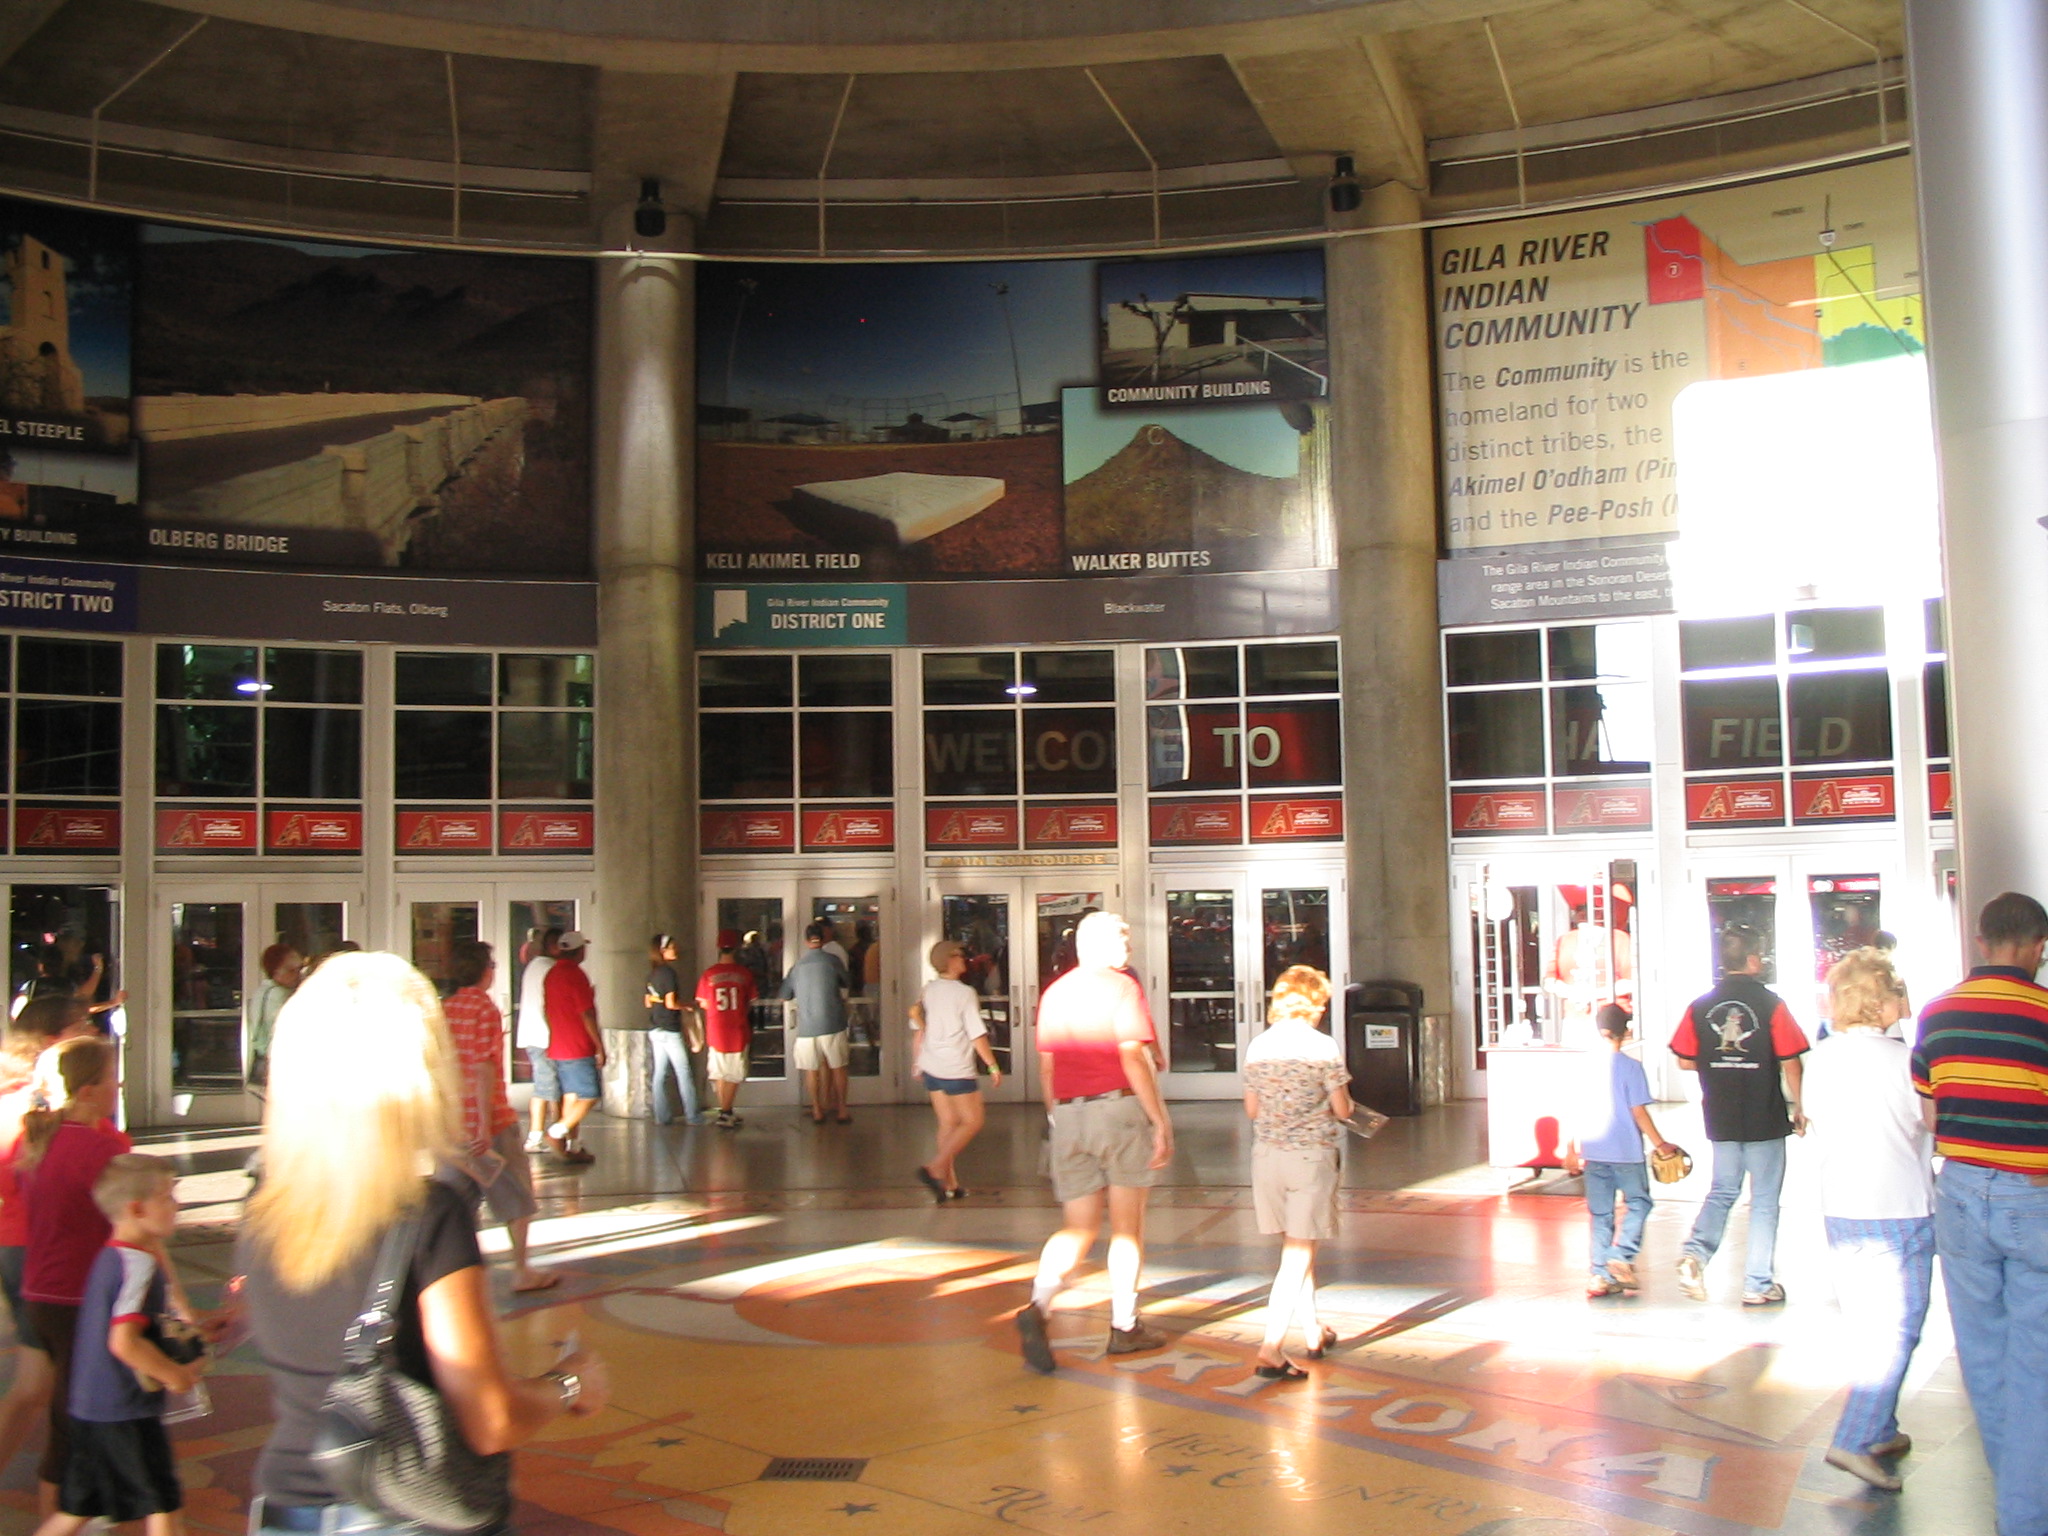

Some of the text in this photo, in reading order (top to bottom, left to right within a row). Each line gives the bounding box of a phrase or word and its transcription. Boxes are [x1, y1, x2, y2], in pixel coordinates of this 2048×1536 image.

[1441, 231, 1610, 275] GILA RIVER
[1442, 276, 1550, 313] INDIAN
[1444, 302, 1641, 350] COMMUNITY
[1442, 350, 1689, 392] The Community is the
[1108, 379, 1271, 403] COMMUNITY BUILDING
[1446, 391, 1648, 427] homeland for two
[16, 420, 85, 441] STEEPLE
[1447, 425, 1663, 463] distinct tribes, the
[1450, 472, 1526, 497] Akimel
[1533, 465, 1627, 491] O'odham
[1450, 511, 1491, 534] and
[1500, 508, 1538, 529] the
[1548, 496, 1653, 526] Pee-Posh
[149, 528, 289, 554] OLBERG BRIDGE
[706, 552, 862, 569] KELI AKIMEL FIELD
[1072, 550, 1212, 572] WALKER BUTTES
[1482, 553, 1665, 577] The Gila River Indian Community
[27, 574, 60, 586] Indian
[61, 576, 118, 591] Community
[1491, 581, 1523, 595] range
[1525, 580, 1550, 591] area
[1566, 576, 1586, 588] the
[1587, 573, 1634, 587] Sonoran
[70, 593, 115, 614] TWO
[323, 598, 371, 615] Sacaton
[409, 602, 450, 619] Olberg
[841, 597, 890, 609] Community
[1104, 600, 1166, 616] Blackwater
[1490, 597, 1536, 610] Sacaton
[1539, 593, 1597, 607] Mountains
[1598, 592, 1611, 602] to
[1613, 590, 1633, 602] the
[771, 612, 886, 629] DISTRICT ONE
[928, 726, 1281, 773] WELCOE TO
[1710, 717, 1852, 760] FIELD
[941, 855, 1106, 867] MAIN CONCOURSE
[715, 986, 739, 1011] 51
